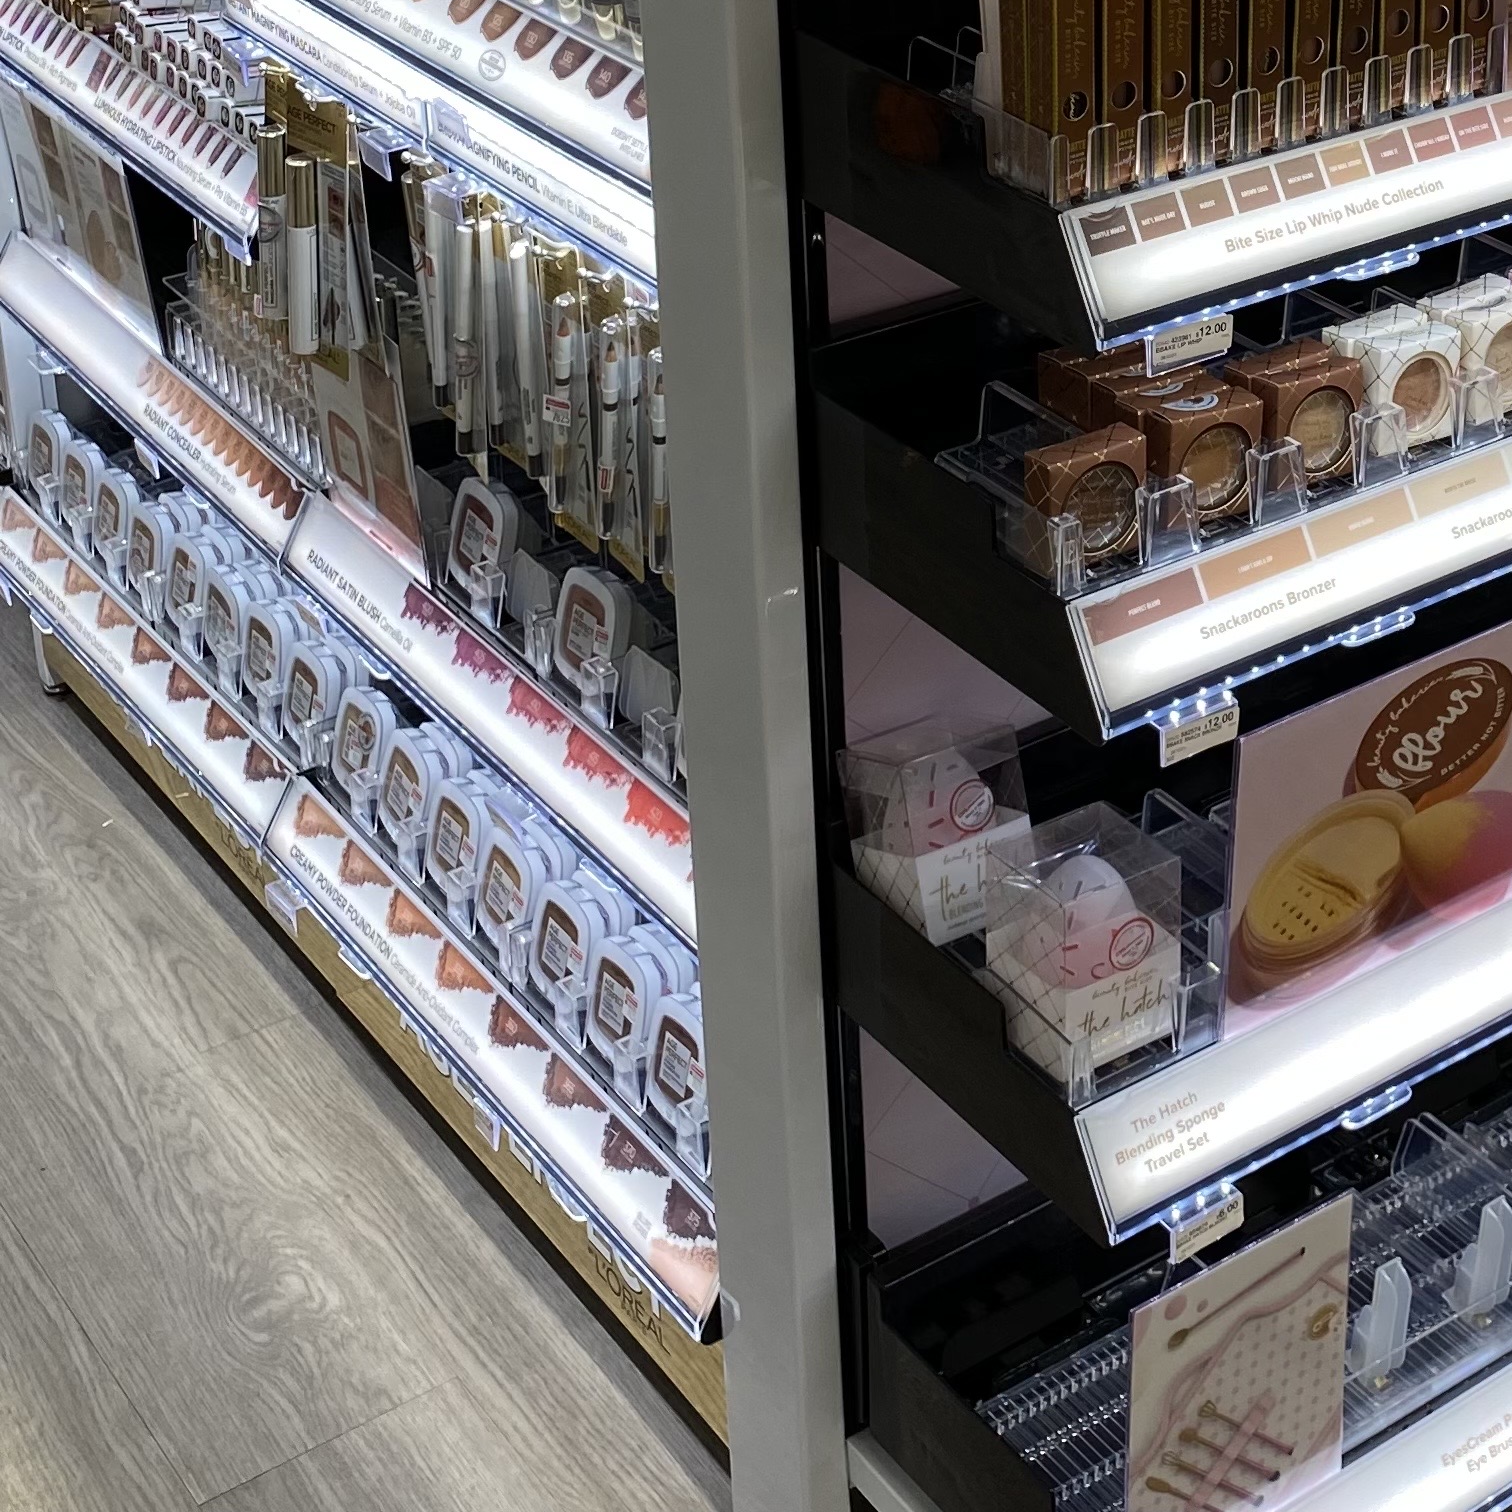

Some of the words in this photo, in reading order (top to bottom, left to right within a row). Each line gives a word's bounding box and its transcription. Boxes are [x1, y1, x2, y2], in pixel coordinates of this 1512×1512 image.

[1224, 235, 1252, 253] Bite
[1255, 225, 1284, 247] Size
[1286, 219, 1307, 243] Lip
[1309, 208, 1344, 233] Whip
[1345, 197, 1381, 220] Nude
[1382, 178, 1445, 211] Collection
[306, 548, 339, 584] RADIANT
[336, 574, 360, 603] SATIN
[356, 592, 383, 622] BLUSH
[1200, 598, 1285, 641] Snackaroons
[1286, 577, 1338, 612] Bronzer
[289, 844, 320, 881] CREAMY
[345, 902, 393, 961] FOUNDATION
[1115, 1127, 1174, 1167] Blending
[1175, 1099, 1226, 1142] Sponge
[1129, 1114, 1156, 1134] The
[1158, 1090, 1198, 1123] Hatch
[1144, 1146, 1185, 1175] Travel
[1185, 1130, 1211, 1155] Set
[1441, 1421, 1504, 1468] EyesCream
[1466, 1453, 1488, 1473] Eye
